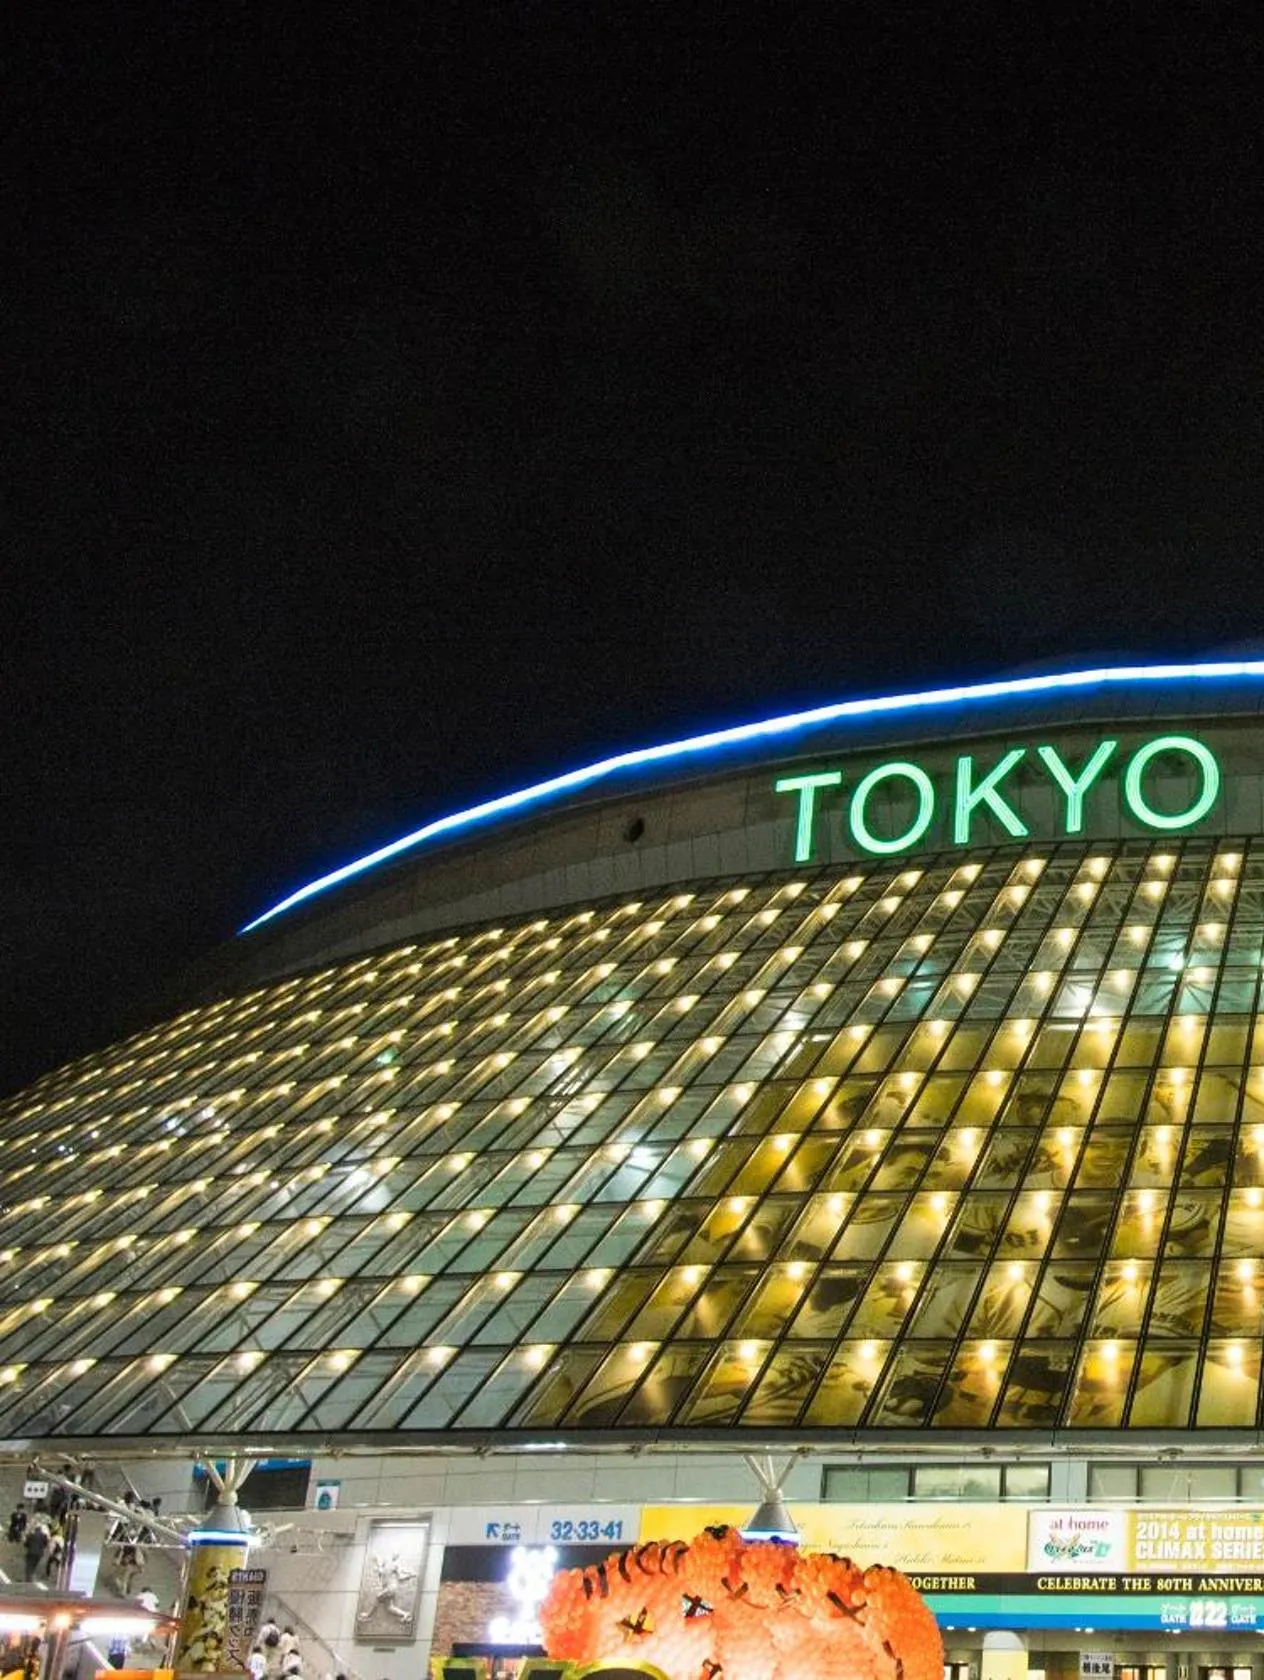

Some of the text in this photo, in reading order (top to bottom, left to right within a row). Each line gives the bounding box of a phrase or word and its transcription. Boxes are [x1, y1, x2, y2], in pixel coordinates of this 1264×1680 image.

[775, 736, 1219, 861] TOKYO
[1050, 1515, 1111, 1531] at home
[1136, 1521, 1264, 1541] 2014 at home
[1136, 1541, 1206, 1560] CLIMAX
[1037, 1576, 1116, 1591] CELEBRATE
[1122, 1577, 1151, 1591] THE
[1157, 1577, 1192, 1591] 80TH
[1160, 1614, 1187, 1624] GATE
[1231, 1614, 1257, 1624] GATE
